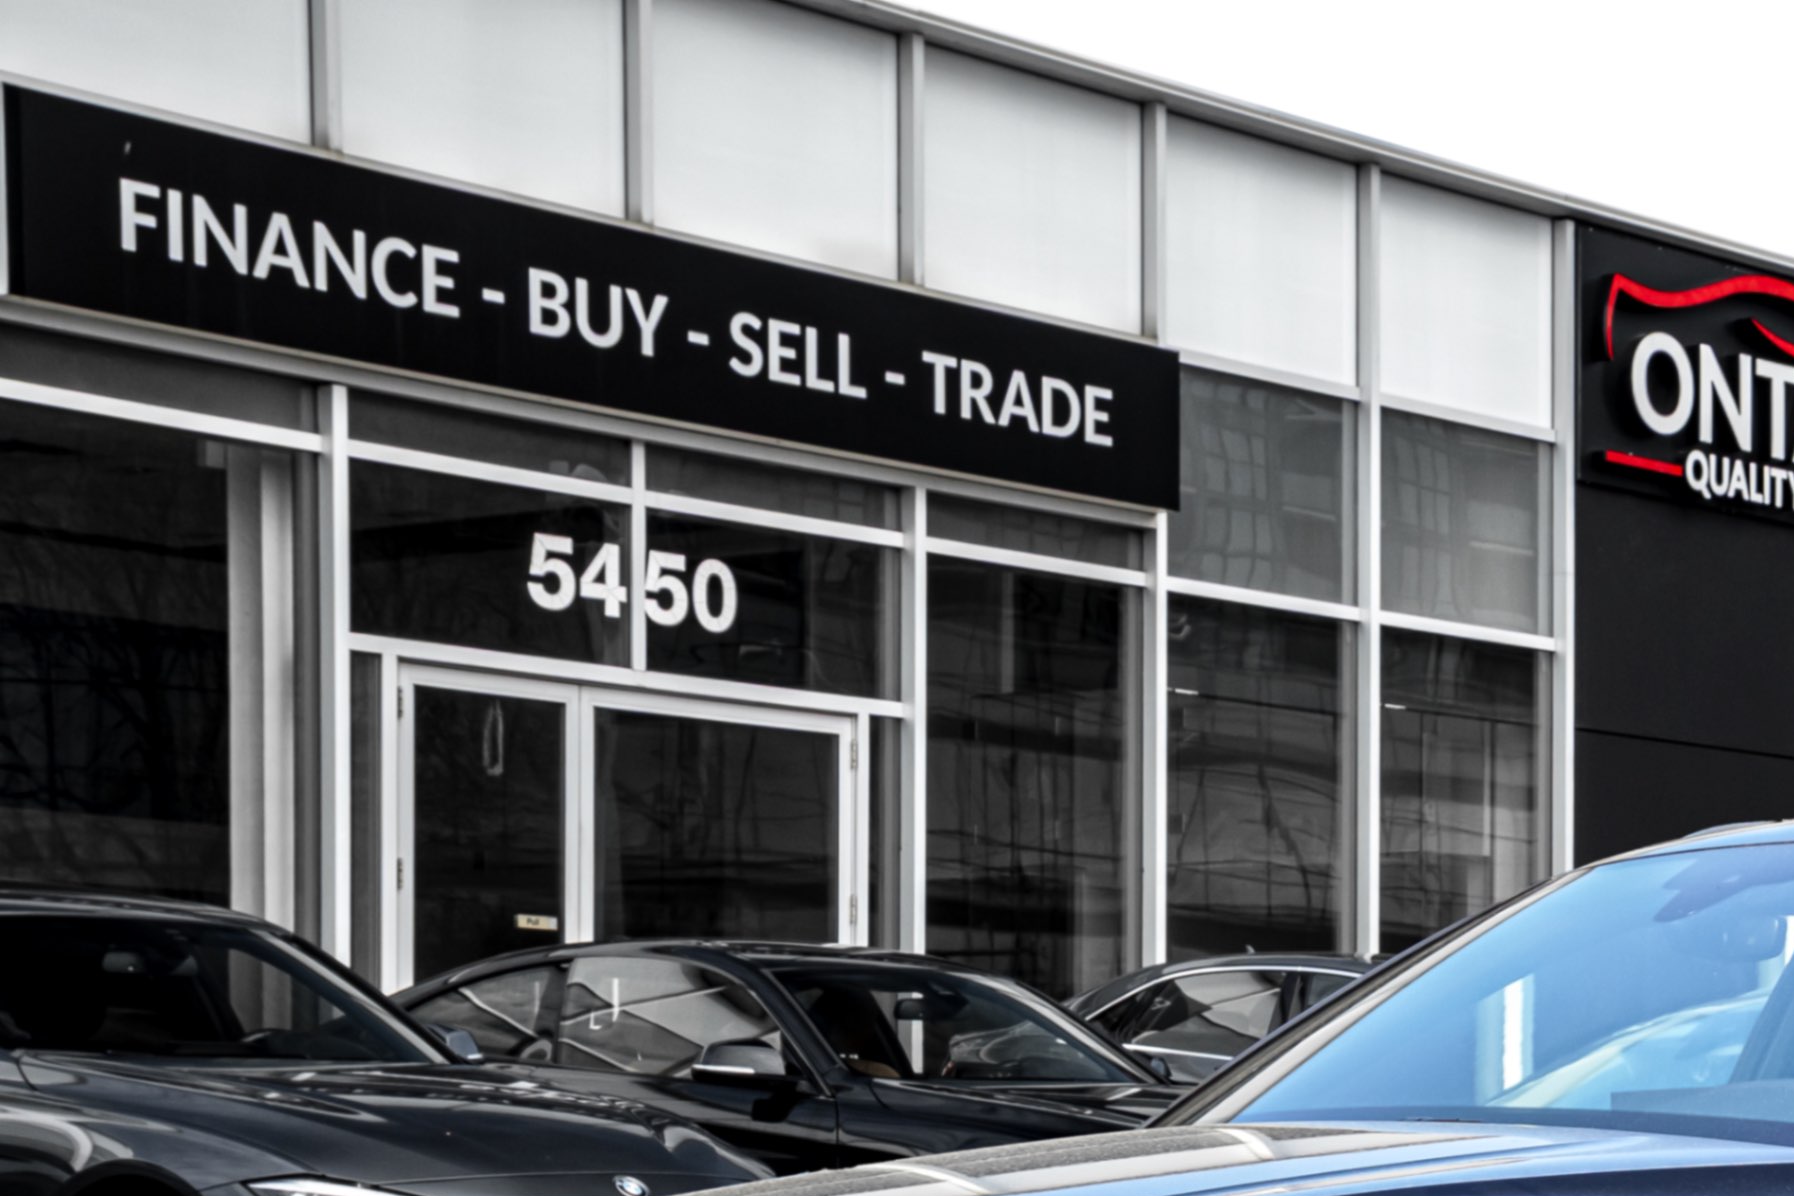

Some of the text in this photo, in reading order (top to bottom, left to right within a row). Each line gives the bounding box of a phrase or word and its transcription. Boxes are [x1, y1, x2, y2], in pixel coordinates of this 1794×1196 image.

[119, 177, 461, 319] FINANCE
[528, 267, 669, 358] BUY
[728, 311, 868, 399] SELL
[921, 350, 1114, 447] TRADE
[526, 532, 738, 634] 5450
